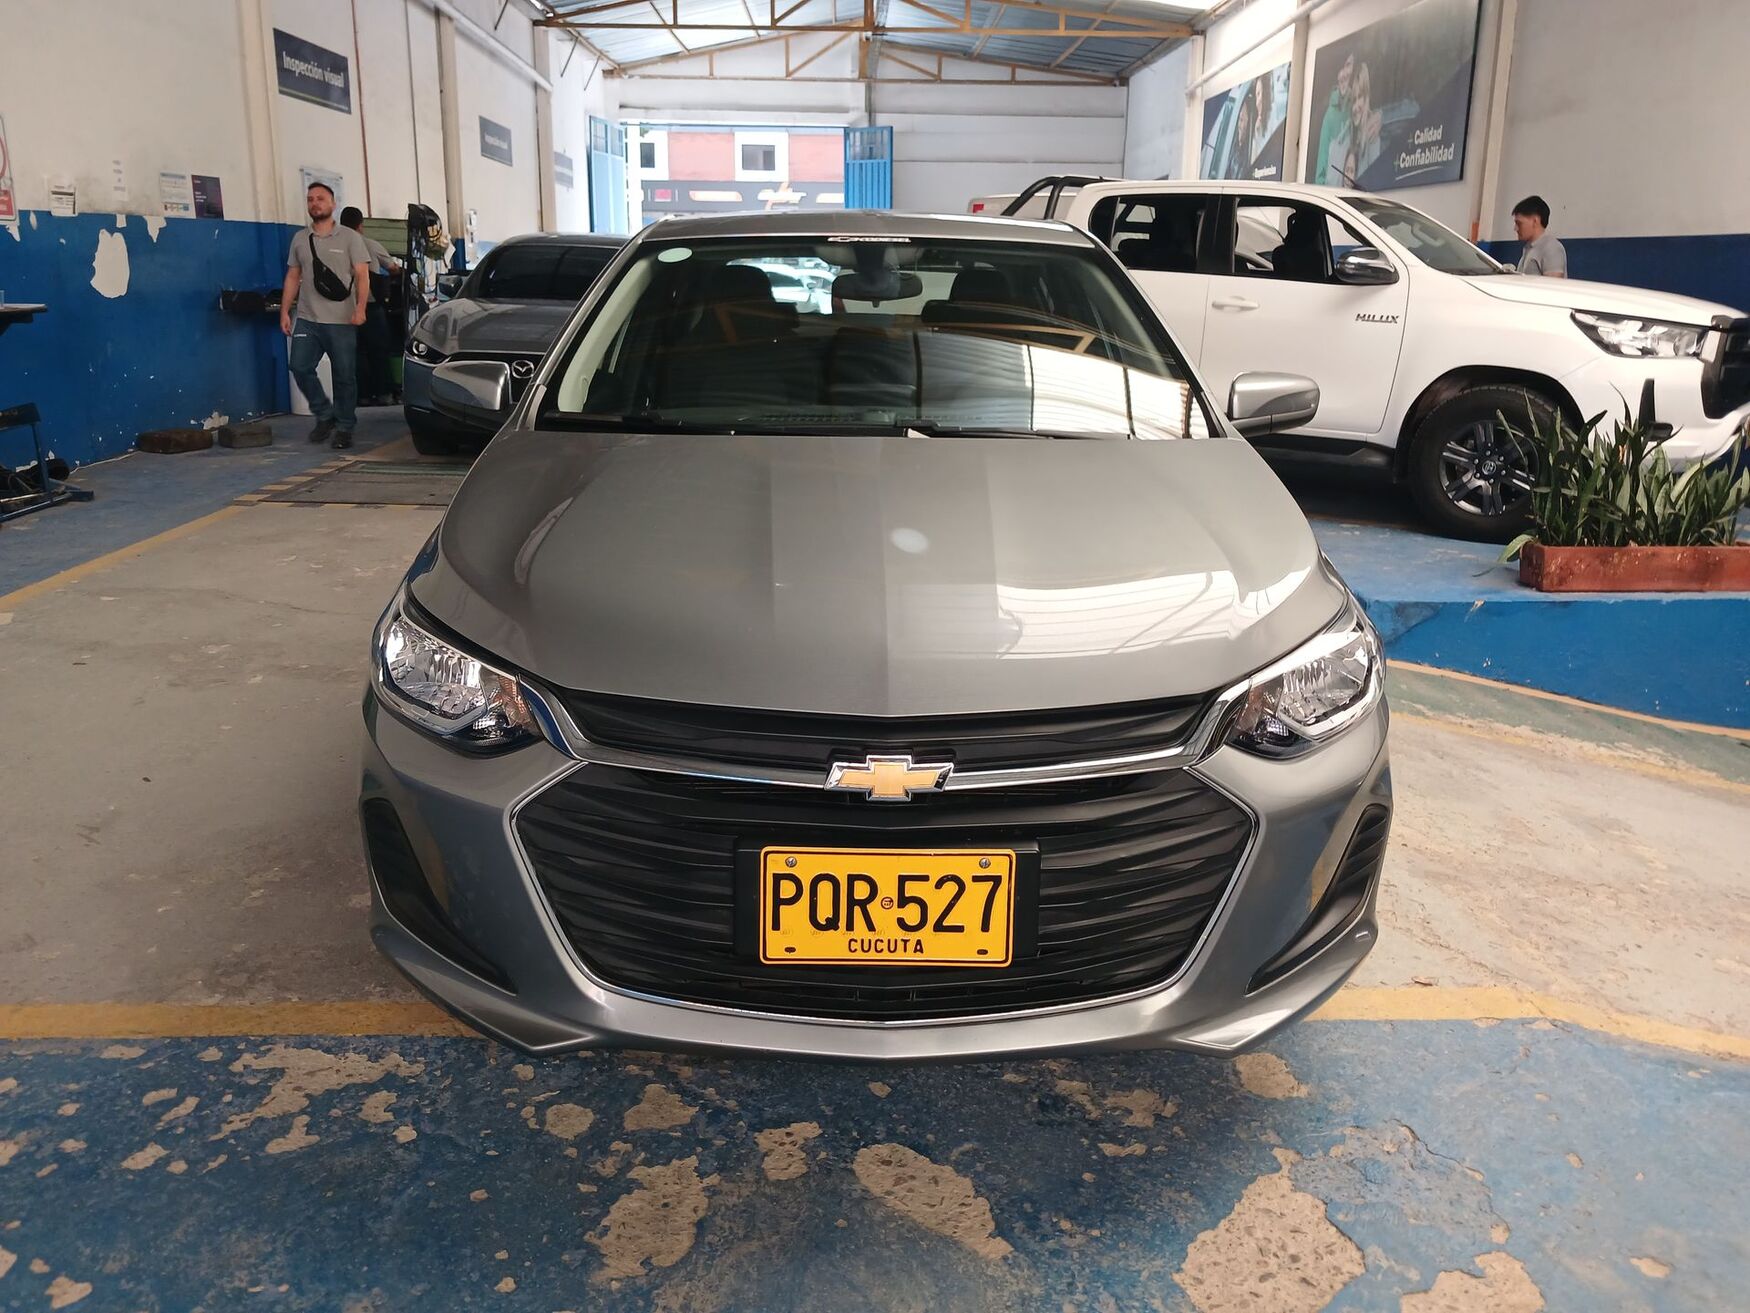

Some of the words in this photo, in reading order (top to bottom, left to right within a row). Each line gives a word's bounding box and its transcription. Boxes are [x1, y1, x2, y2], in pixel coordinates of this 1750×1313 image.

[282, 50, 324, 81] Inspección
[1355, 313, 1400, 324] HILUX
[847, 938, 924, 954] CUCUTA
